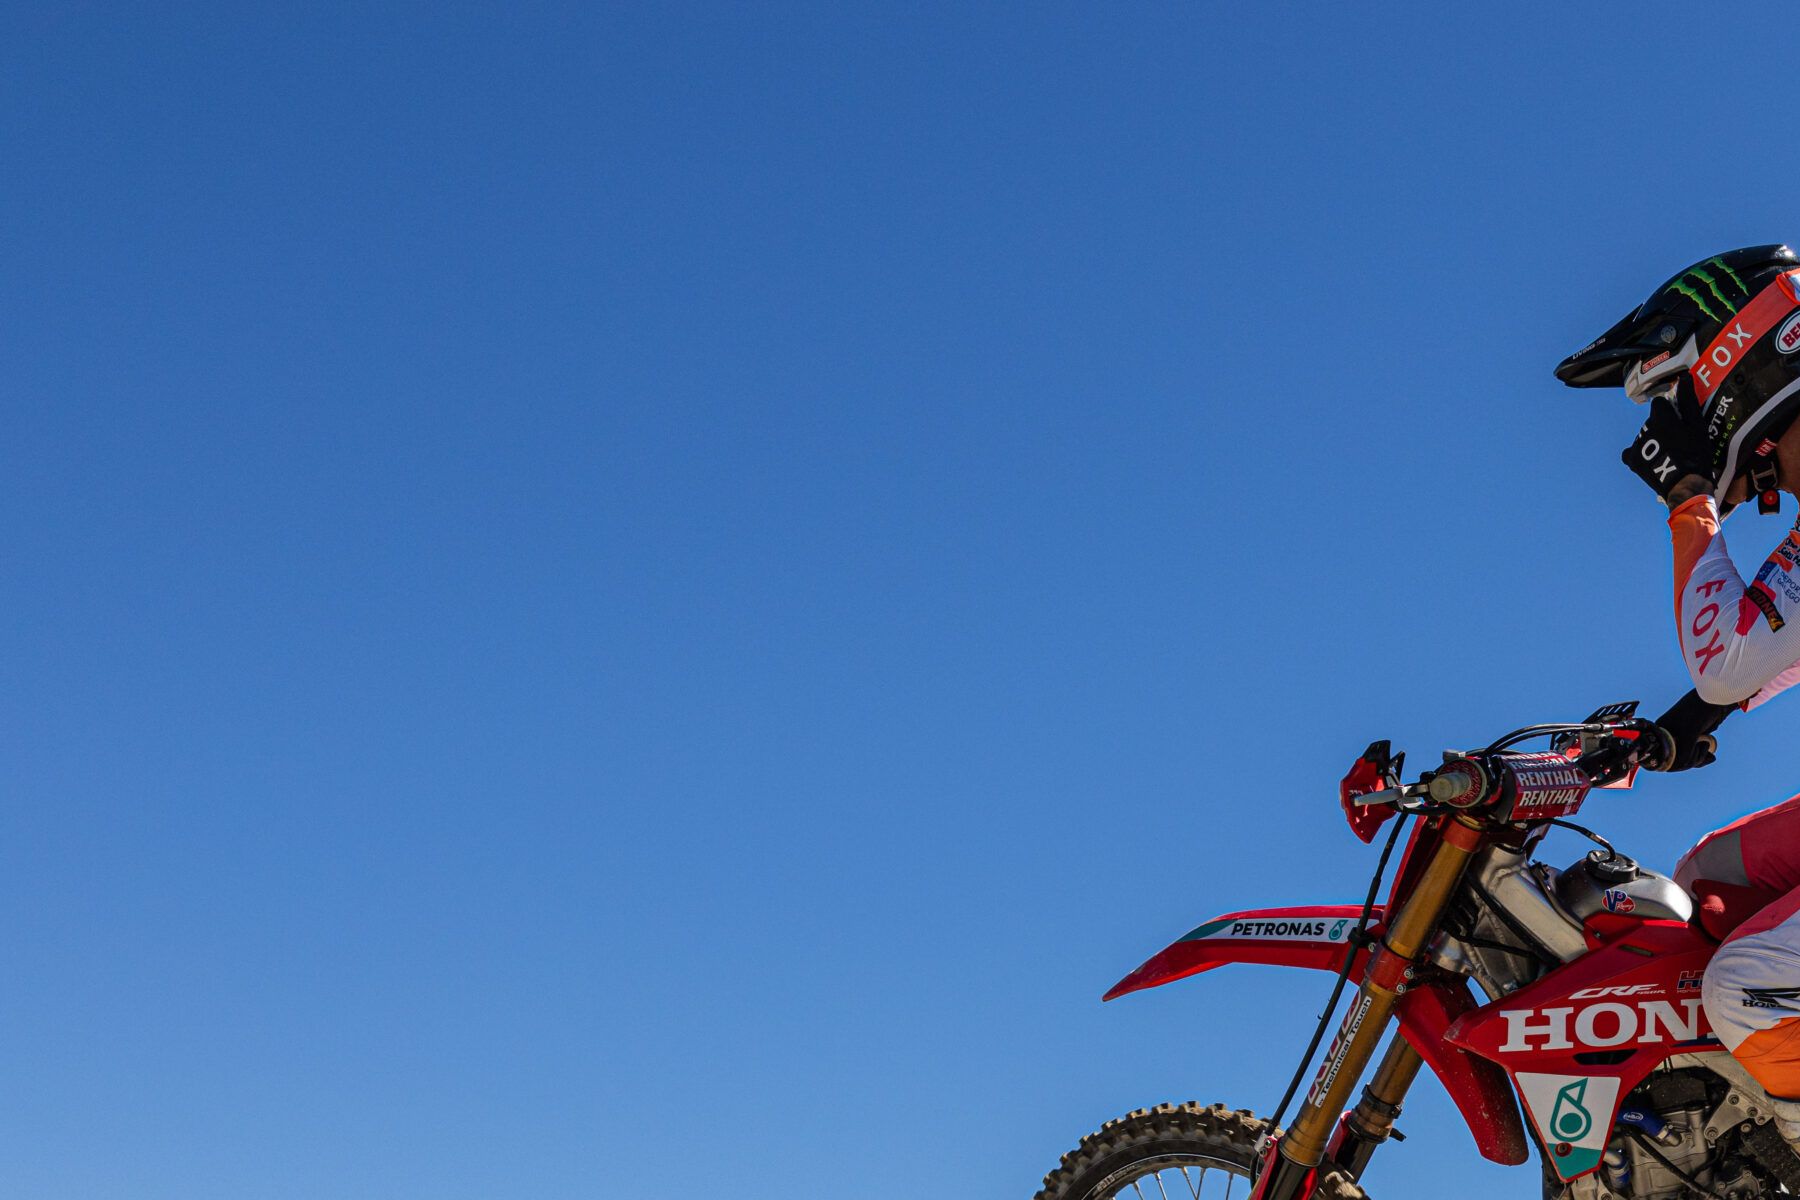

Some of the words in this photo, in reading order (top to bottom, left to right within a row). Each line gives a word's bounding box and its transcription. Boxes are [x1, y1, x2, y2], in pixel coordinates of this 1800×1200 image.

[1696, 322, 1753, 388] FOX
[1692, 578, 1727, 676] FOX
[1516, 770, 1582, 787] RENTHAL
[1519, 788, 1580, 807] RENTHAL
[1605, 889, 1627, 912] VP
[1231, 922, 1325, 937] PETRONAS
[1568, 983, 1660, 1000] CRF
[1498, 998, 1718, 1053] HON
[1320, 1039, 1351, 1097] Technical
[1349, 999, 1371, 1035] Touch
